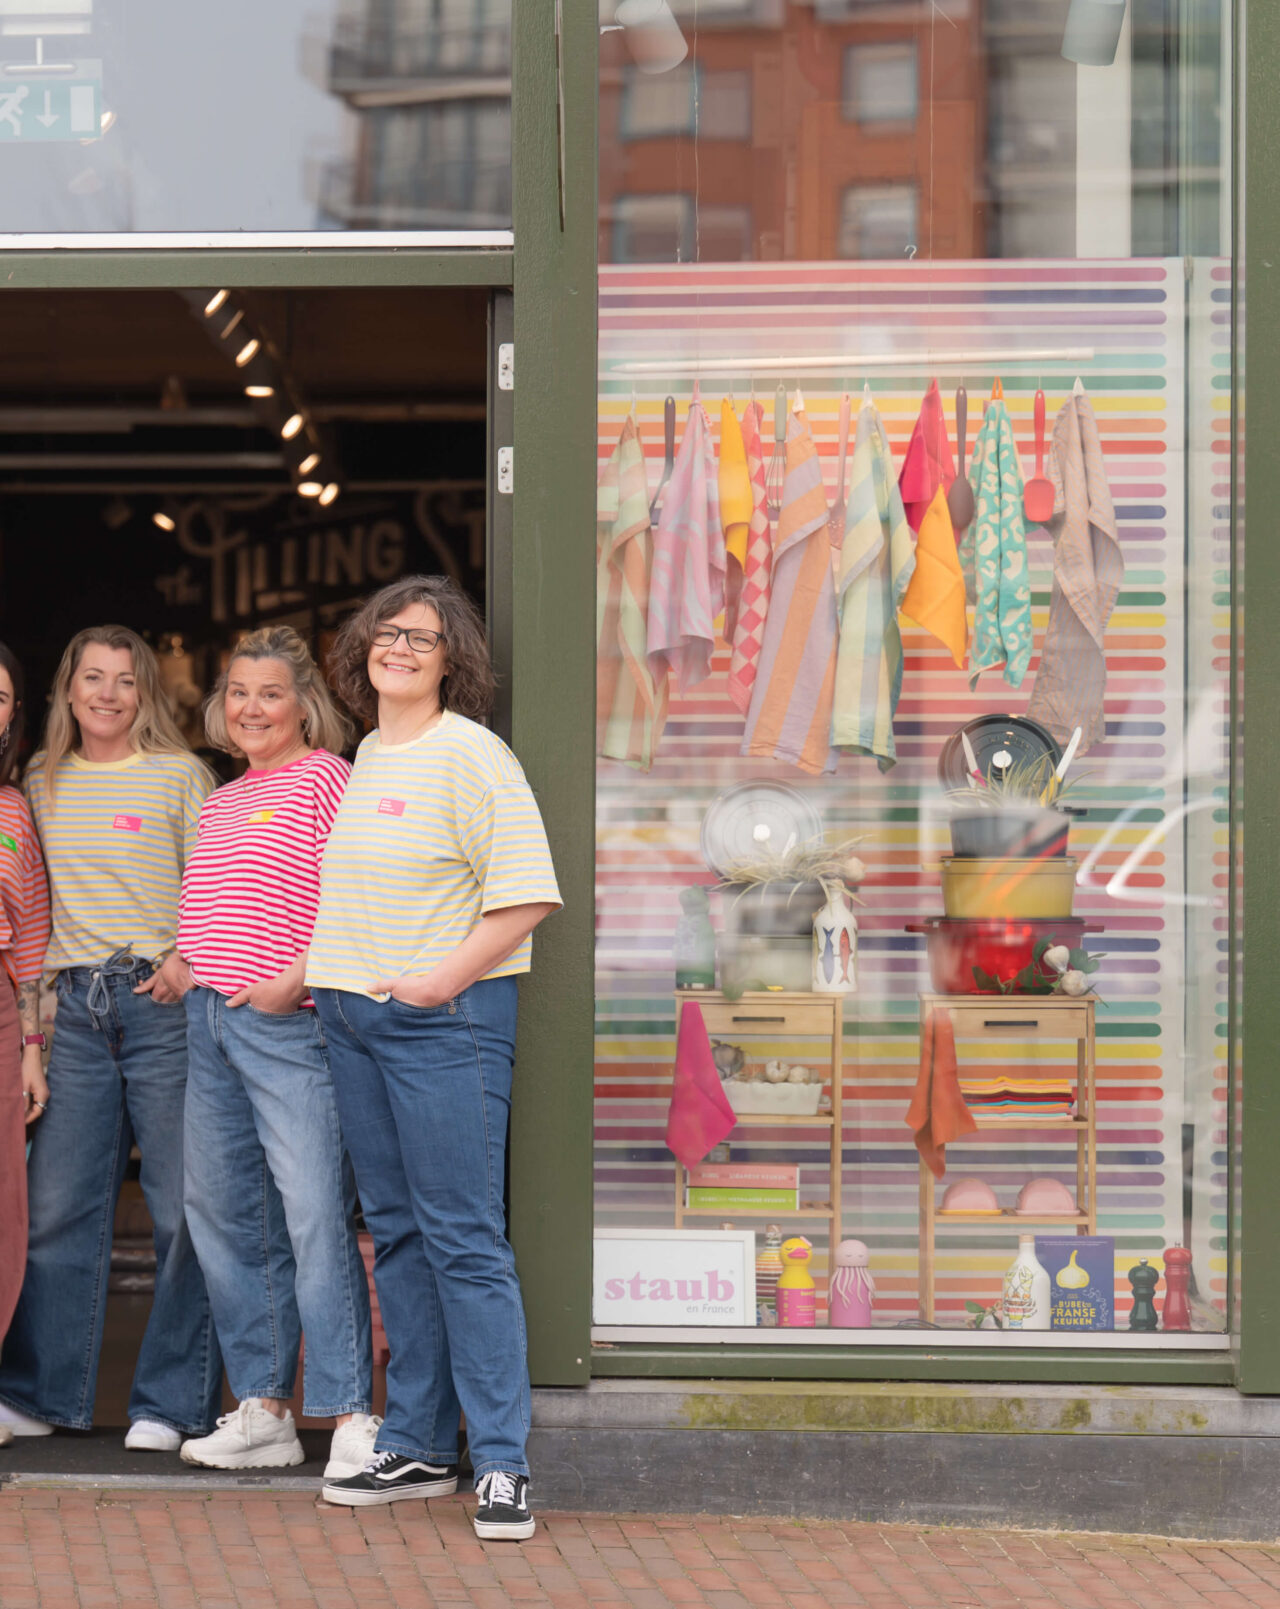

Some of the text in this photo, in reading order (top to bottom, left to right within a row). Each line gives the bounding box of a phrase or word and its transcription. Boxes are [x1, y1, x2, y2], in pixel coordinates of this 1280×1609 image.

[604, 1269, 735, 1302] staub
[702, 1304, 735, 1313] France
[1050, 1308, 1096, 1318] FRANSE
